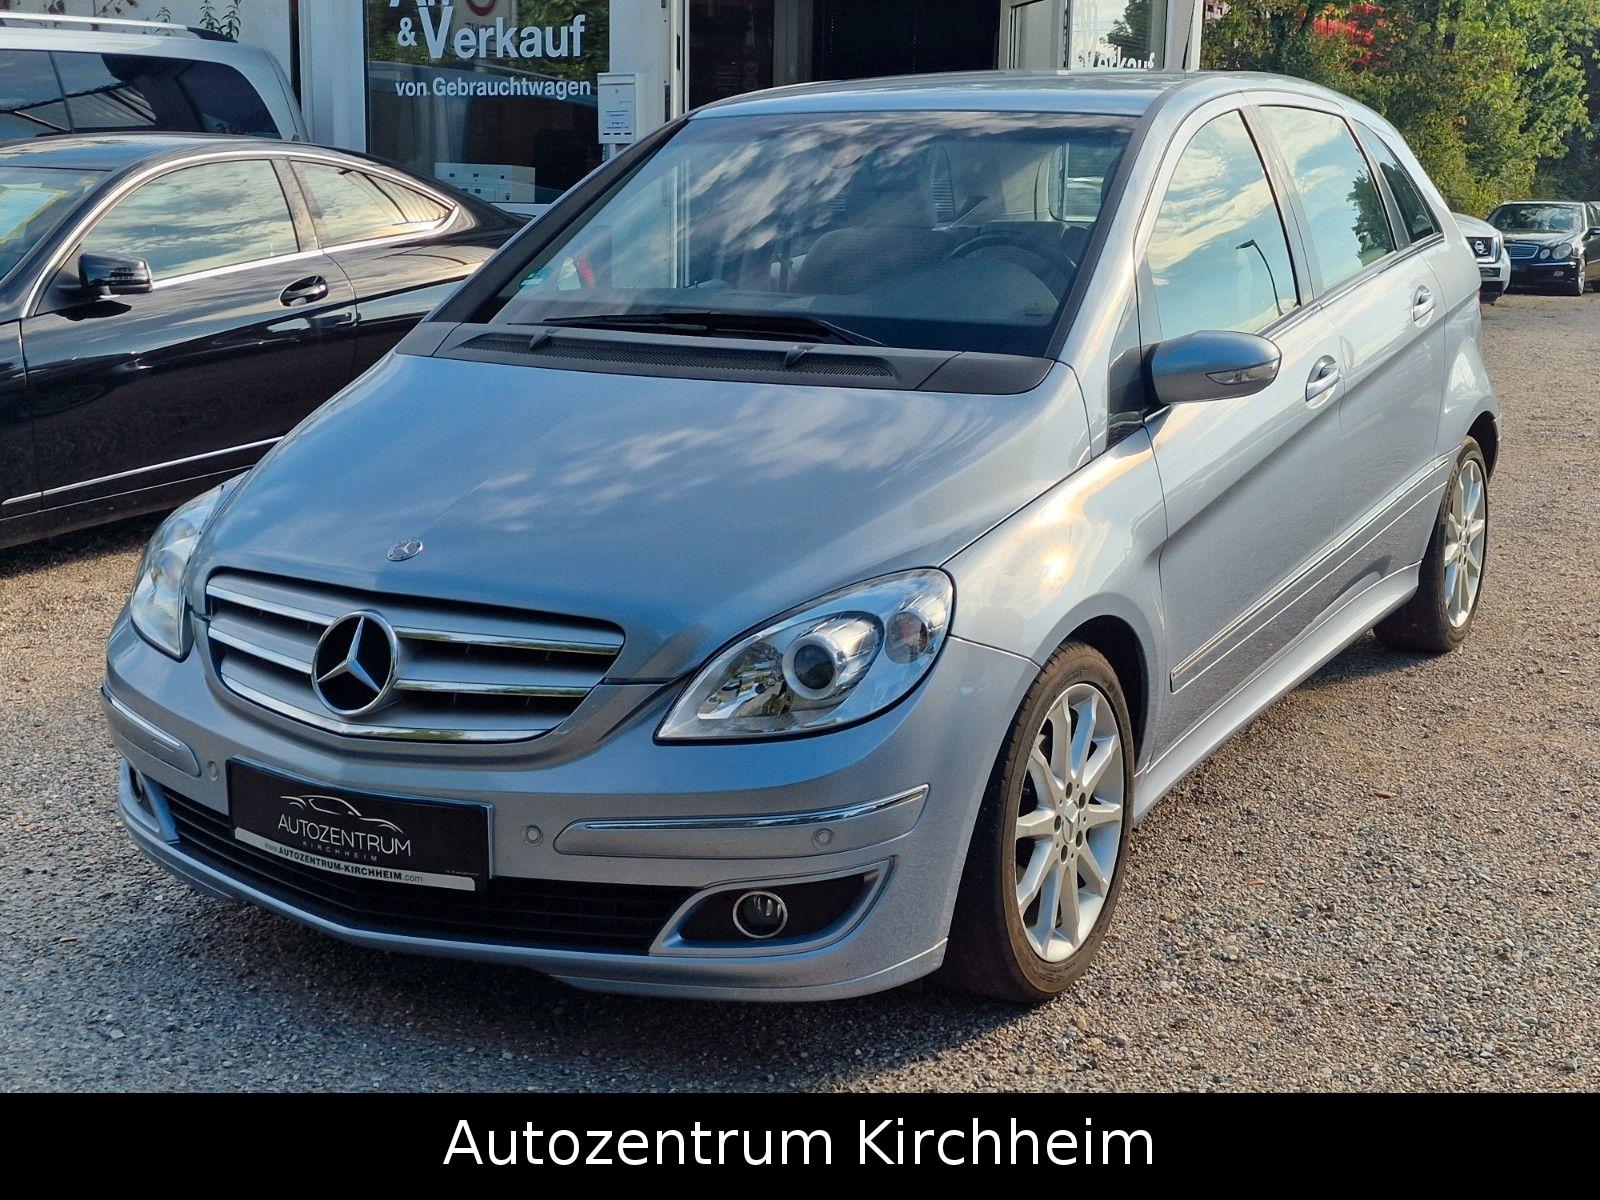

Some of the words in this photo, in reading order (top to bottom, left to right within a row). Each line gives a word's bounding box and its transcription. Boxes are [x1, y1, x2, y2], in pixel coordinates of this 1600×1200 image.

[418, 6, 585, 59] Verkauf
[395, 82, 427, 96] von
[432, 77, 591, 100] Gebrauchtwagen
[277, 813, 412, 857] AUTOZENTRUM
[302, 840, 378, 862] KIRCHHEIM
